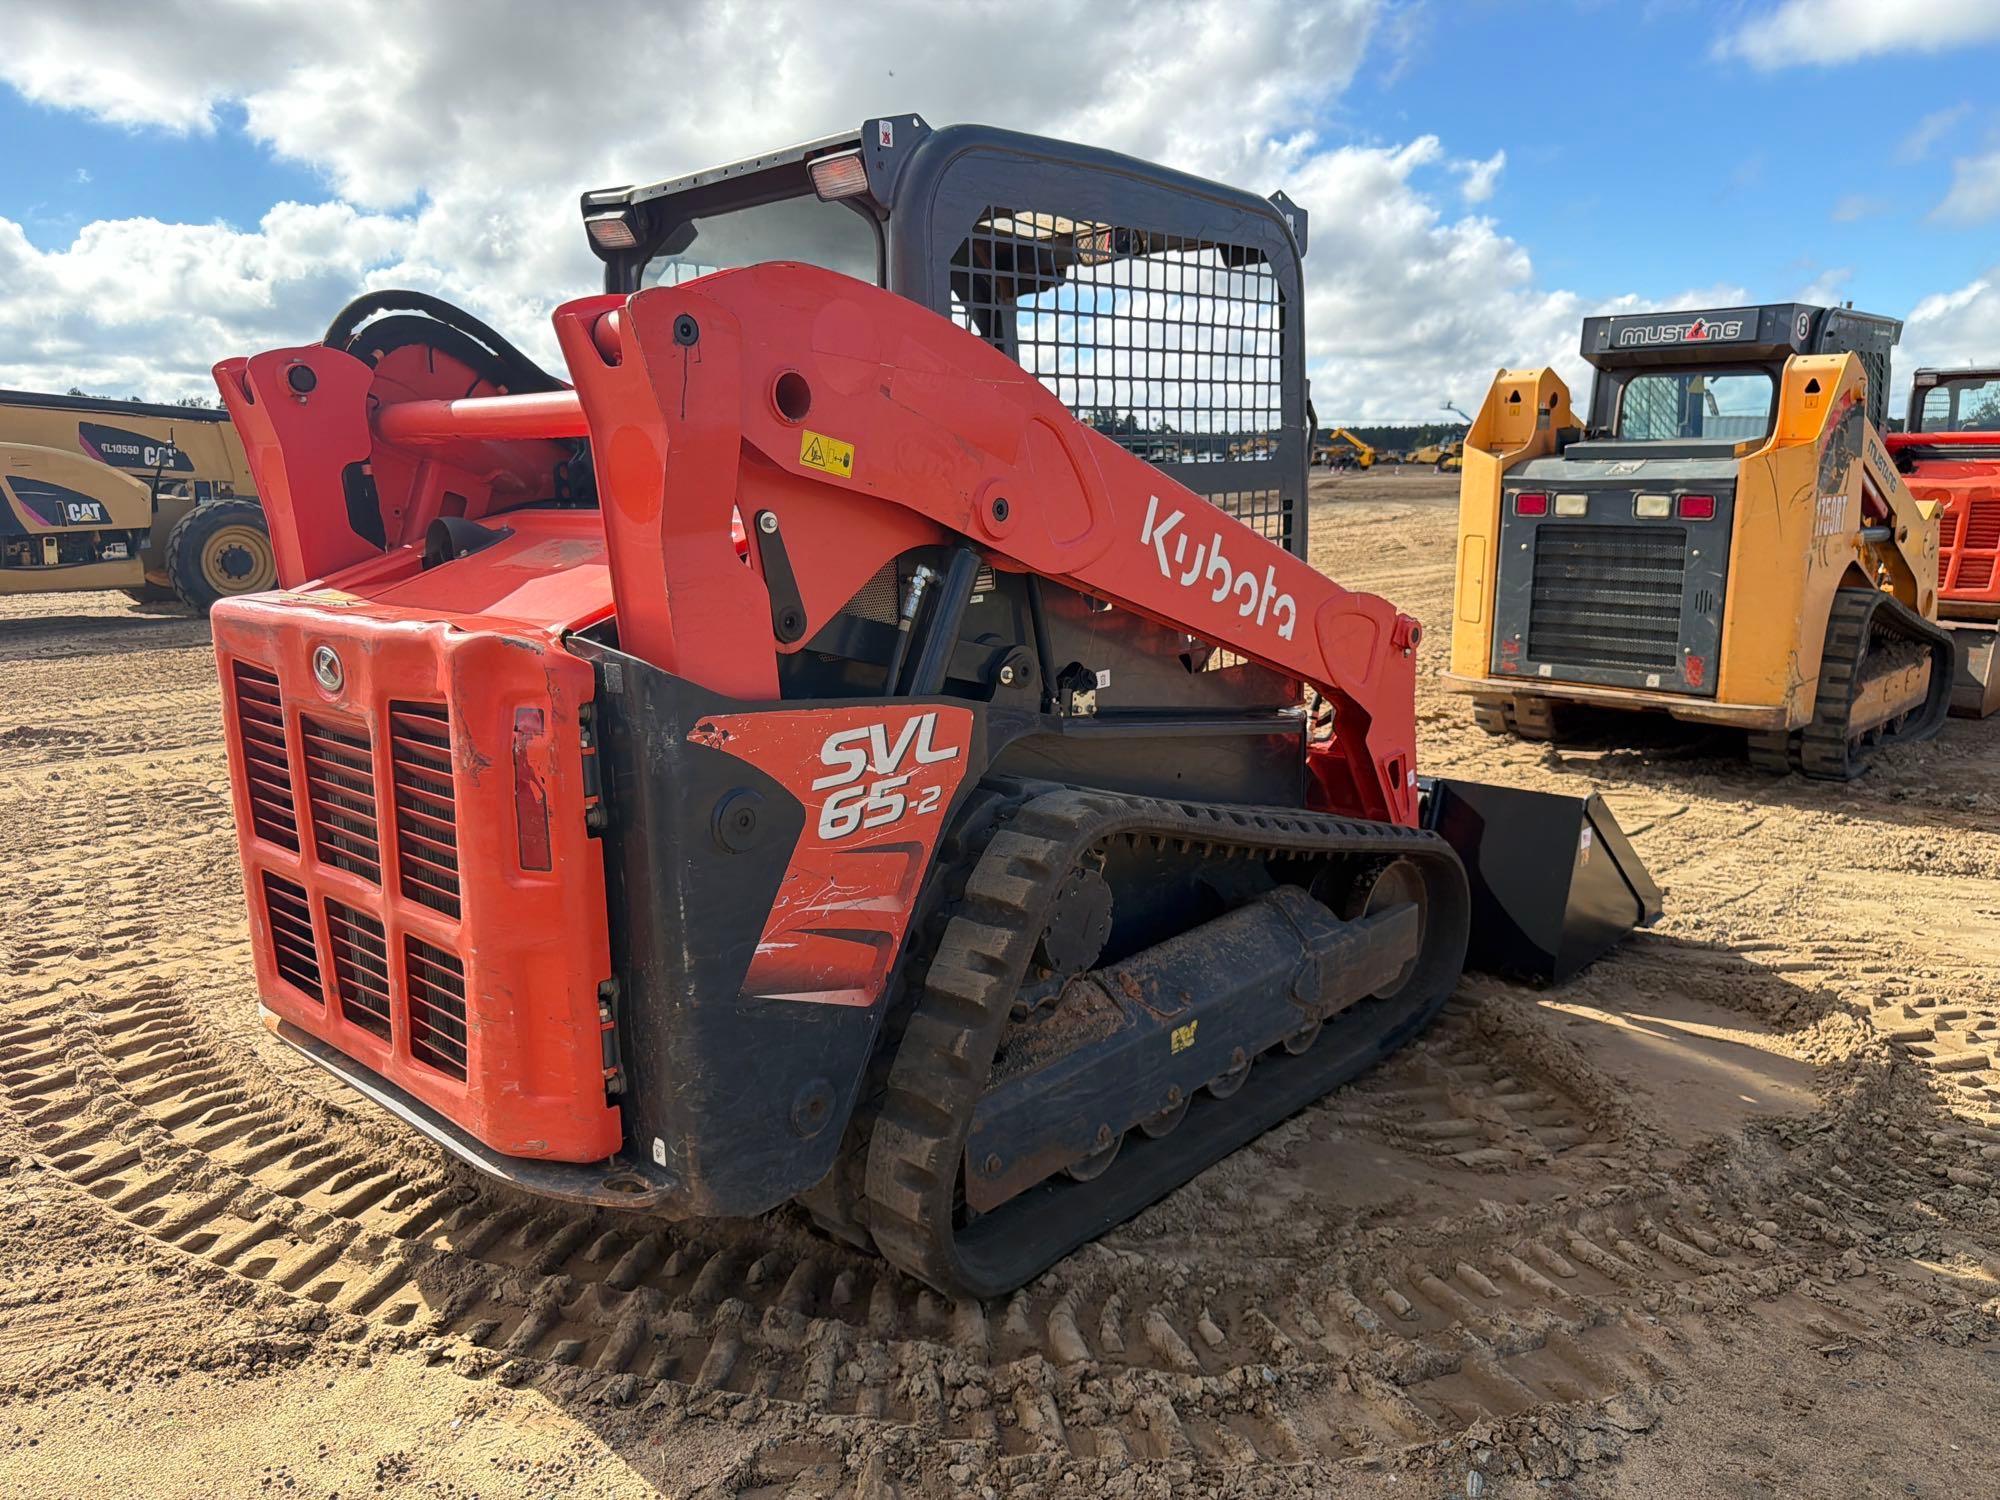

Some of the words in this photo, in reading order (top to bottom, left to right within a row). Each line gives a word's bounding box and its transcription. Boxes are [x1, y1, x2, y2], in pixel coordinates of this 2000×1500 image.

[1867, 439, 1898, 494] MUSTANG
[67, 503, 101, 521] CAT
[1140, 494, 1297, 641] Kubota
[812, 712, 960, 792] SVL
[818, 775, 943, 840] 65-2
